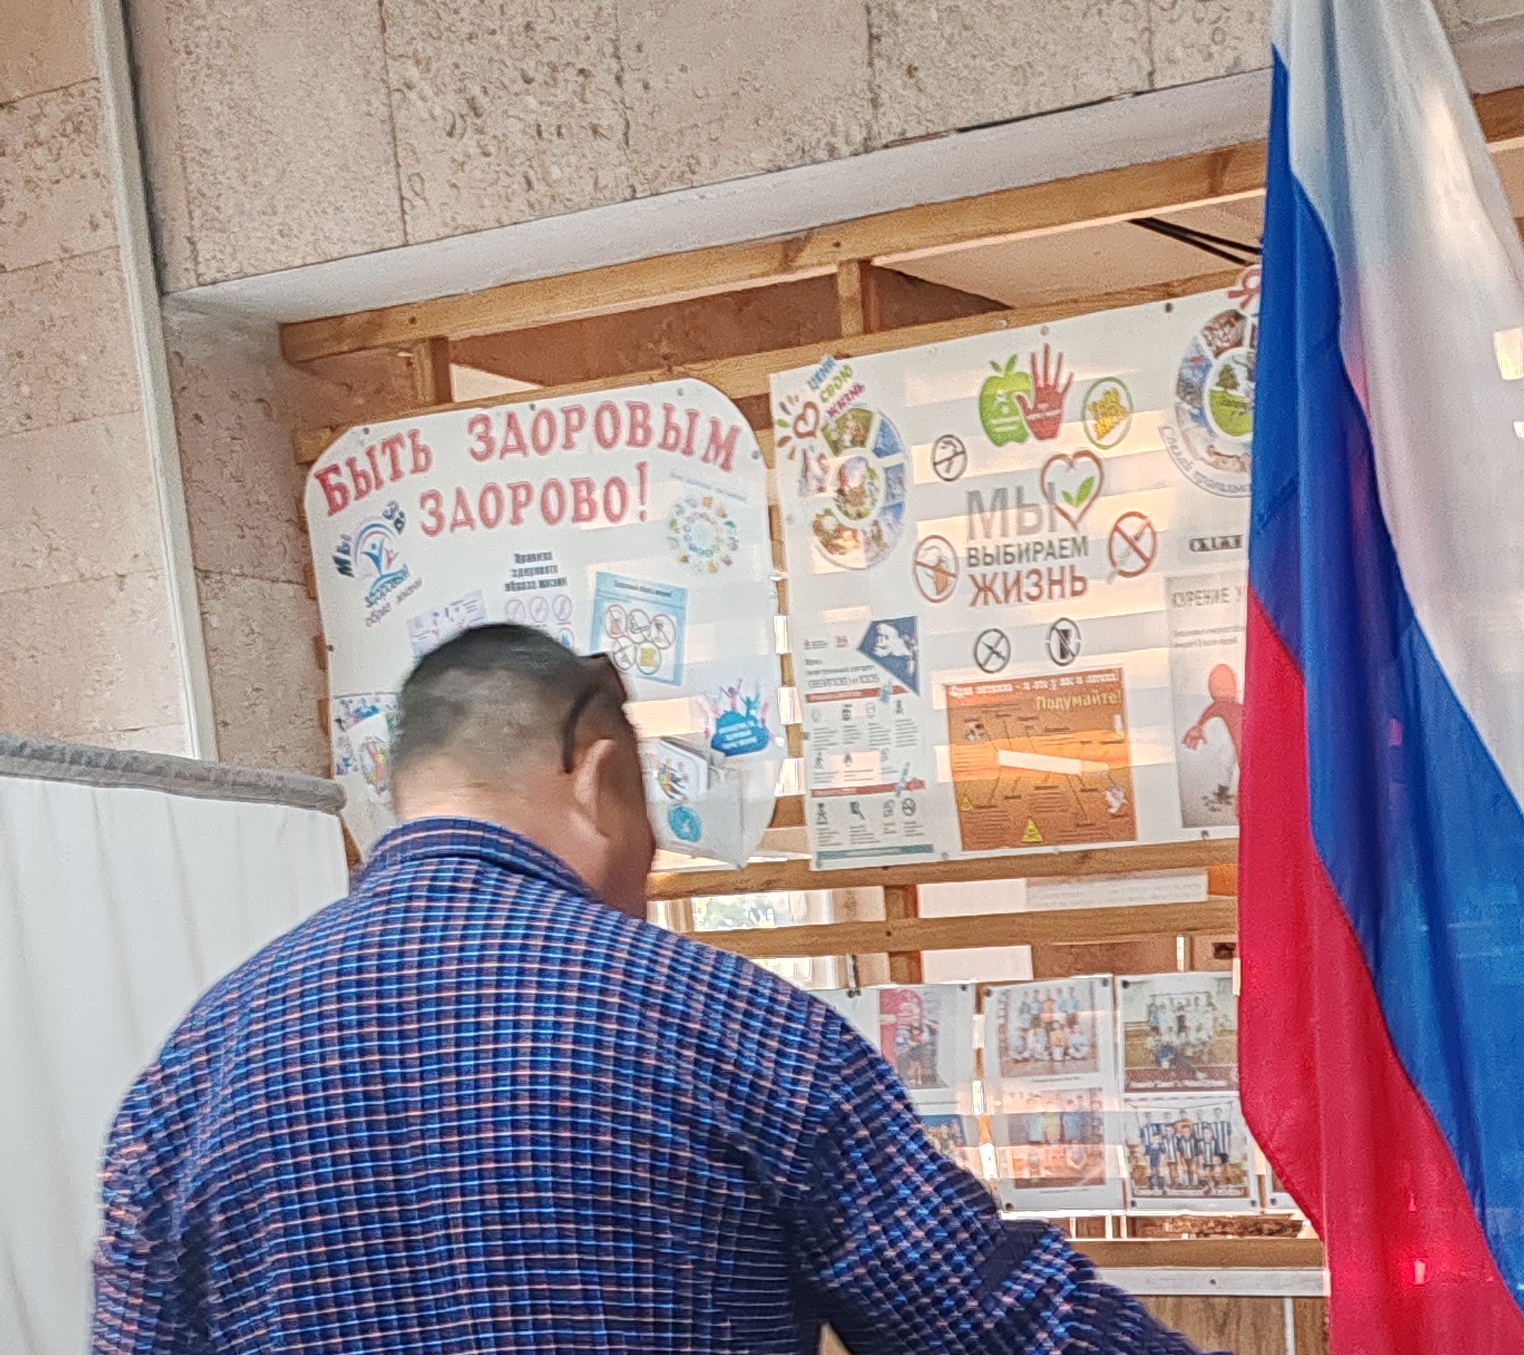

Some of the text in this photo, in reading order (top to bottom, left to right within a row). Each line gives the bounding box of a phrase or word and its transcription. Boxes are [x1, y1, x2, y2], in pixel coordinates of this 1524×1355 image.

[314, 400, 741, 517] БЫТЬ ЗДОРОВЫМ
[420, 461, 649, 538] ЗДОРОВО!
[965, 482, 1058, 541] МЫ
[966, 535, 1089, 568] ВЫБИРАЕМ
[968, 564, 1088, 607] ЖИЗНЬ
[1036, 688, 1122, 711] Подумайте!
